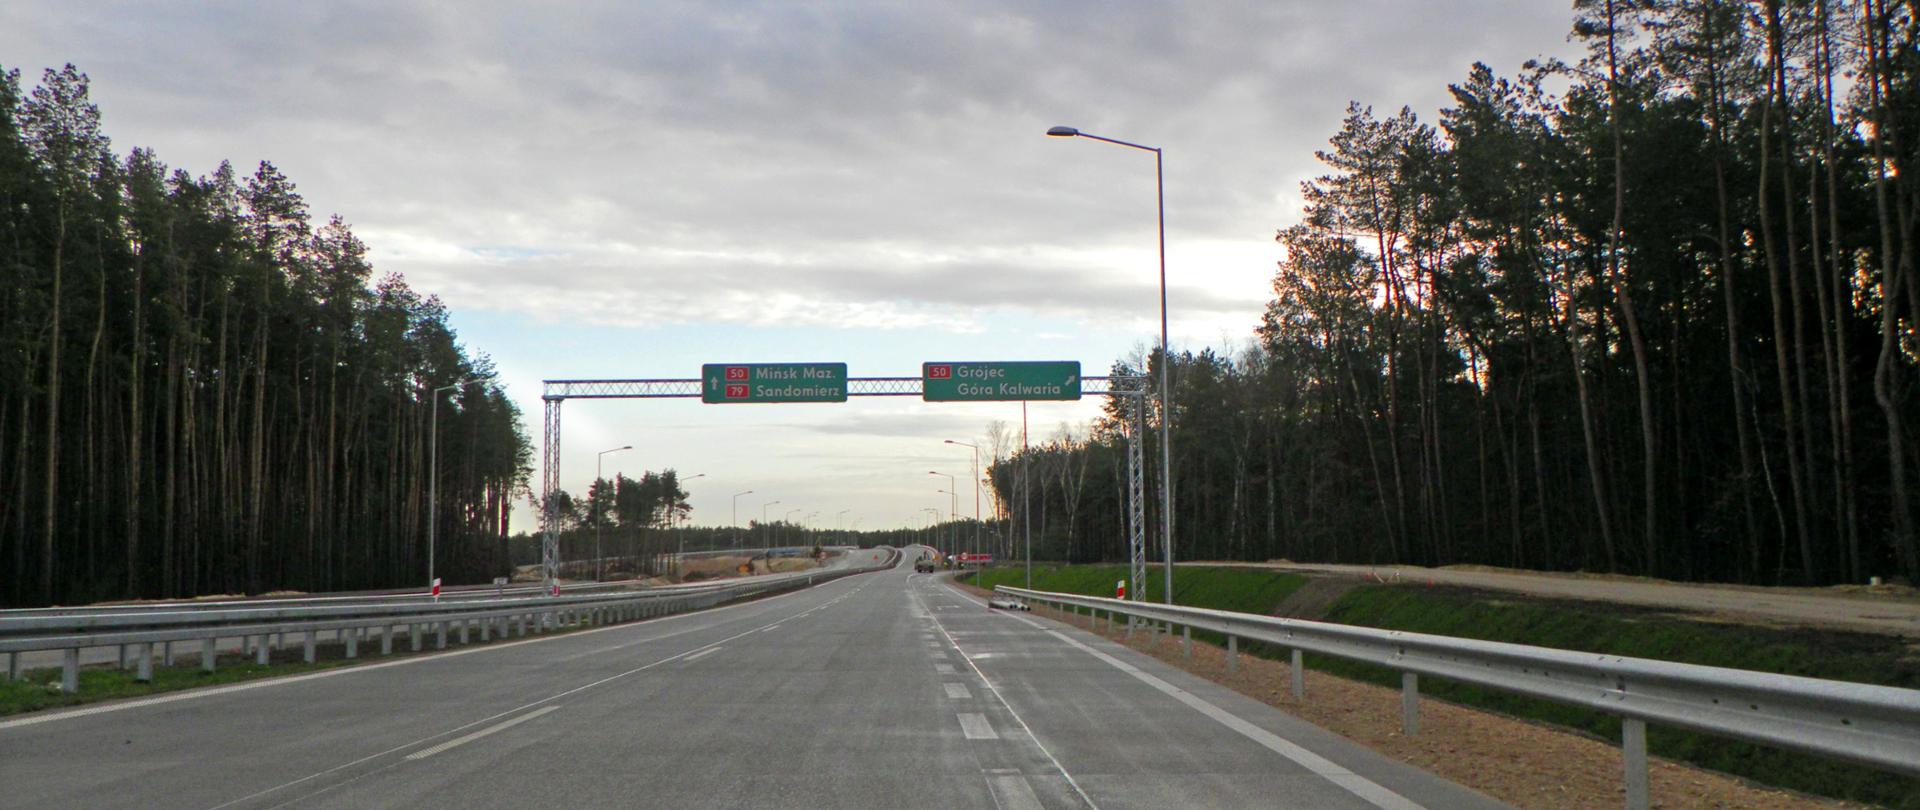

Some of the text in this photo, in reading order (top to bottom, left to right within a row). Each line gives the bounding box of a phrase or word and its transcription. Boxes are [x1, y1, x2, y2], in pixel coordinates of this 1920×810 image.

[731, 369, 744, 378] 50
[756, 366, 836, 379] Mińsk Maz.
[933, 367, 946, 376] 50
[957, 365, 1005, 380] Grójec
[731, 386, 744, 396] 79
[756, 384, 839, 397] Sandomierz
[957, 382, 1061, 395] Góra Kalwaria
